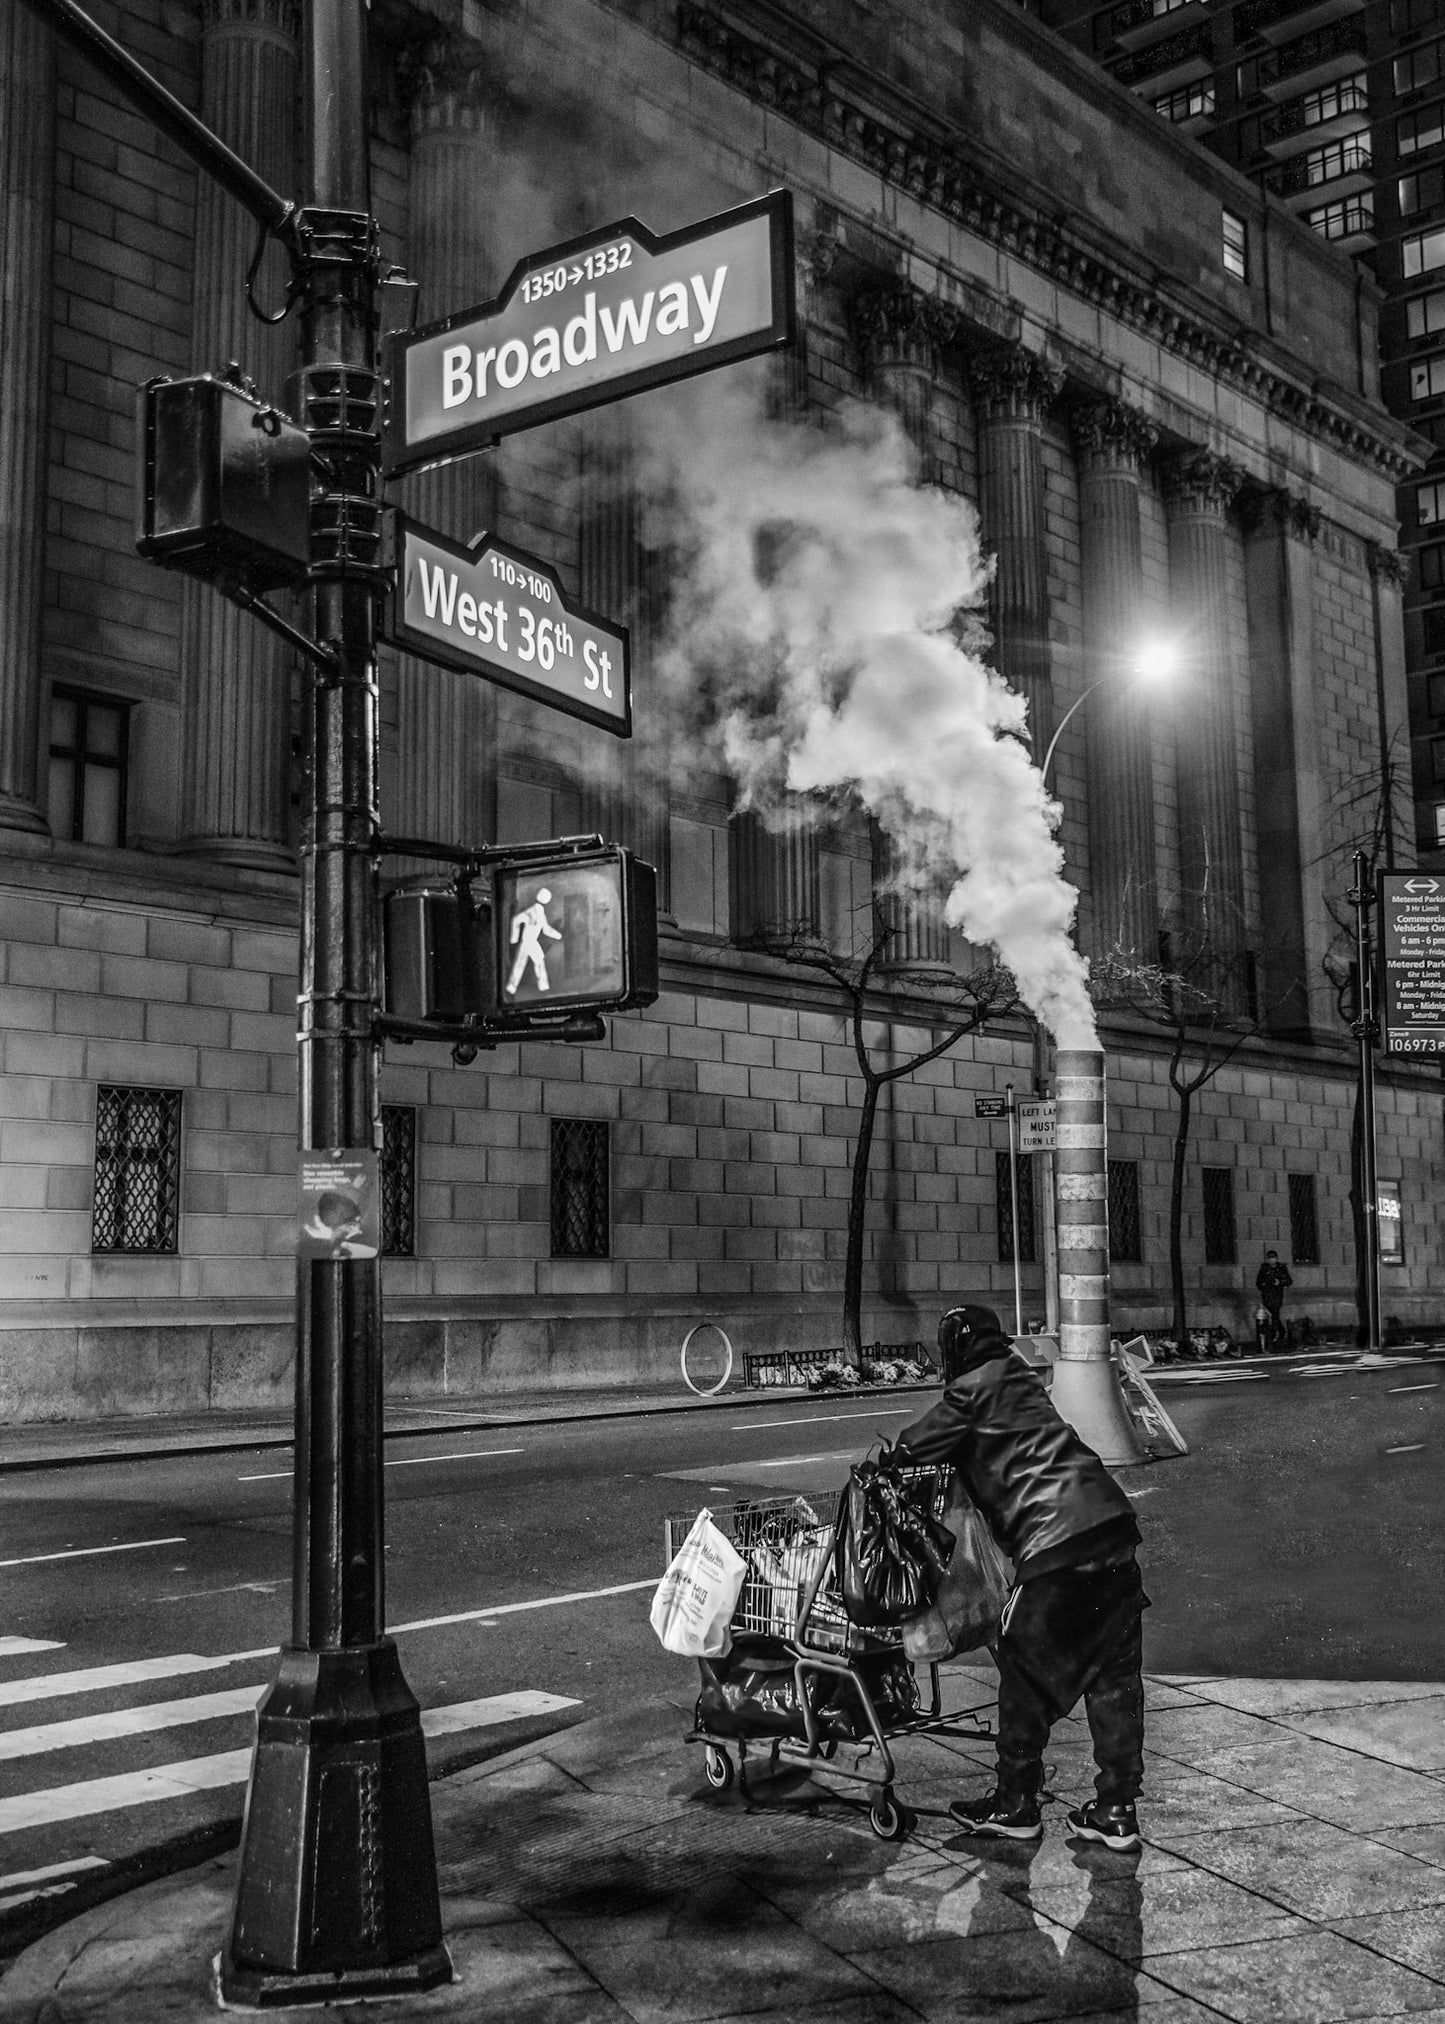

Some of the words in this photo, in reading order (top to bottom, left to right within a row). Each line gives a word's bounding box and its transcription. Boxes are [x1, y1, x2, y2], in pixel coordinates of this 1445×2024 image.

[521, 267, 567, 304] 1350
[583, 243, 633, 281] 1332
[443, 265, 728, 410] Broadway
[490, 557, 515, 586] 110
[527, 575, 551, 603] 100
[419, 558, 508, 652] West
[518, 607, 574, 671] 36th
[583, 640, 613, 699] St
[1391, 895, 1423, 903] Metered
[1424, 895, 1445, 903] Parkin
[1396, 914, 1445, 923] Commercia
[1393, 923, 1430, 932] Vehicles
[1431, 924, 1445, 932] On
[1401, 936, 1407, 945] 6
[1426, 936, 1432, 945] 6
[1432, 937, 1445, 946] pm
[1400, 948, 1424, 957] Monday
[1387, 960, 1425, 968] Metered
[1427, 960, 1445, 968] Park
[1395, 980, 1401, 988] 6
[1401, 981, 1414, 990] pm
[1420, 980, 1445, 990] Midnig
[1400, 991, 1425, 1000] Monday
[1396, 1001, 1402, 1010] 8
[1420, 1001, 1445, 1012] Midnig
[1411, 1011, 1440, 1020] Saturday
[1390, 1039, 1437, 1052] 106973
[1022, 1108, 1039, 1117] LEFT
[1030, 1121, 1055, 1132] MUST
[1023, 1137, 1042, 1146] TURN
[1046, 1137, 1055, 1145] LE
